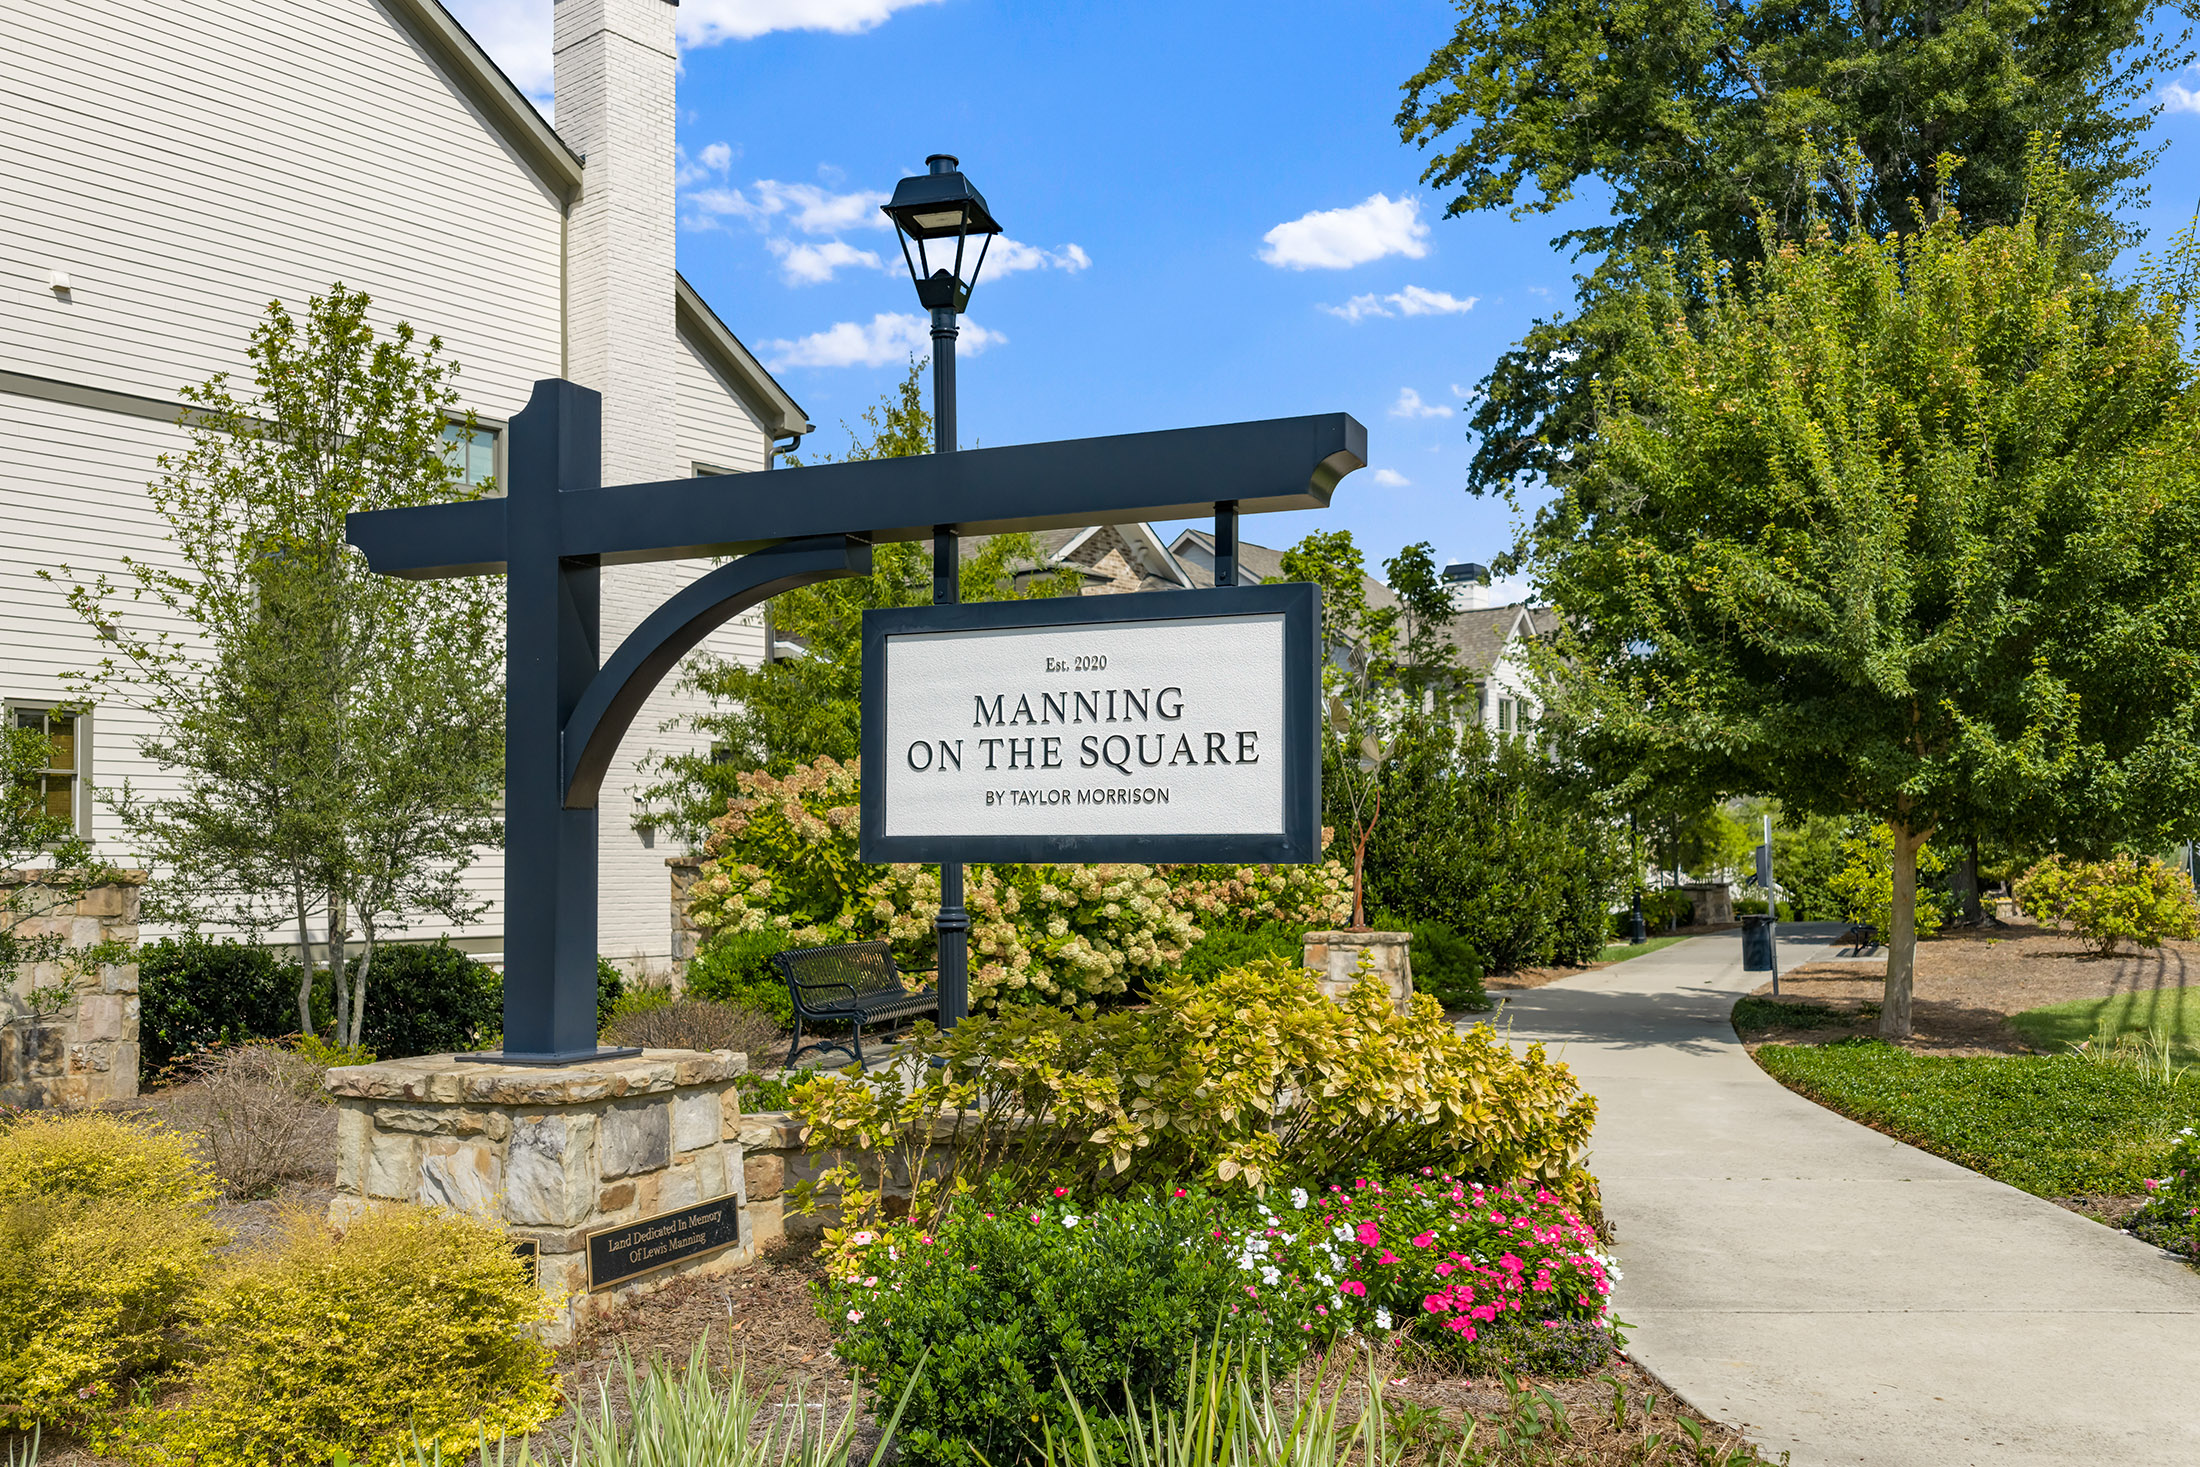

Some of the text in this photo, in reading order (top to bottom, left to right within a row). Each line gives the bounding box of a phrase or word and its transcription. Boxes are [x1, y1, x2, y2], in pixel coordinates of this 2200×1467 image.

[1074, 655, 1108, 671] 2020
[973, 686, 1185, 728] MANNING
[906, 731, 1260, 775] ON THE SQUARE
[986, 787, 1170, 806] BY TAYLOR MORRISON
[608, 1210, 722, 1252] Land Dedicated In Memory
[629, 1232, 706, 1264] Of Lewis Manning
